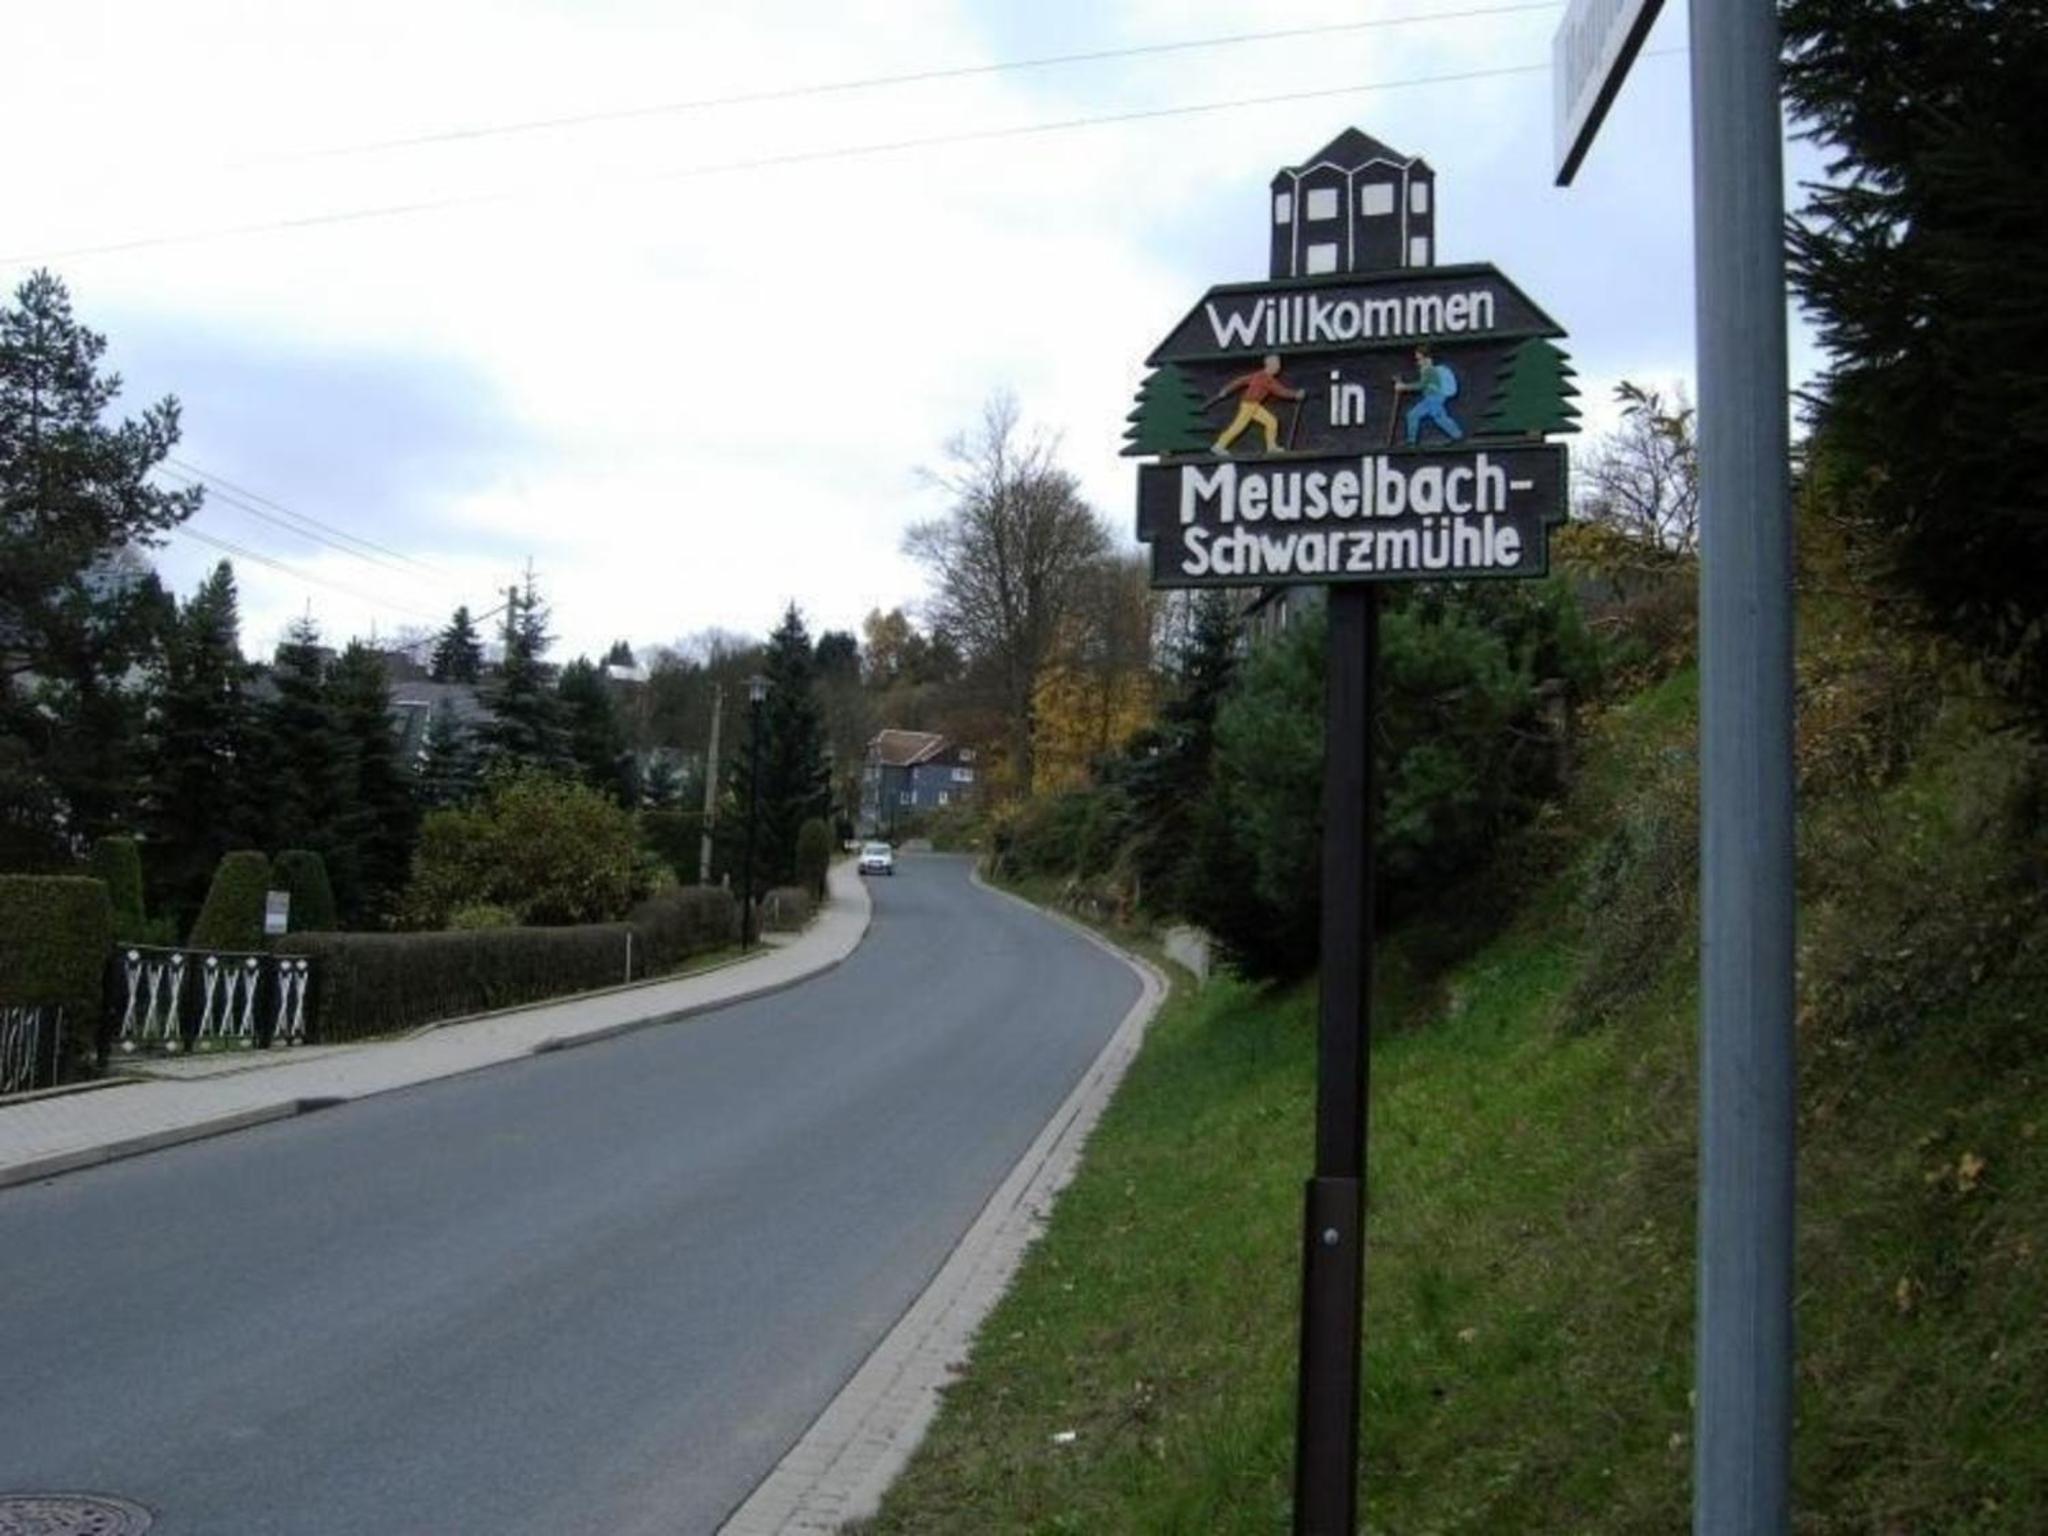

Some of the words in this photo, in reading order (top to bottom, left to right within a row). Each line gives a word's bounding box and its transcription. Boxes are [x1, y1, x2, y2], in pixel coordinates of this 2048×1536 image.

[1206, 290, 1494, 348] Willkommen
[1330, 371, 1365, 426] in
[1180, 453, 1533, 524] Meuselbach-
[1181, 515, 1521, 575] Schwarzmühle
